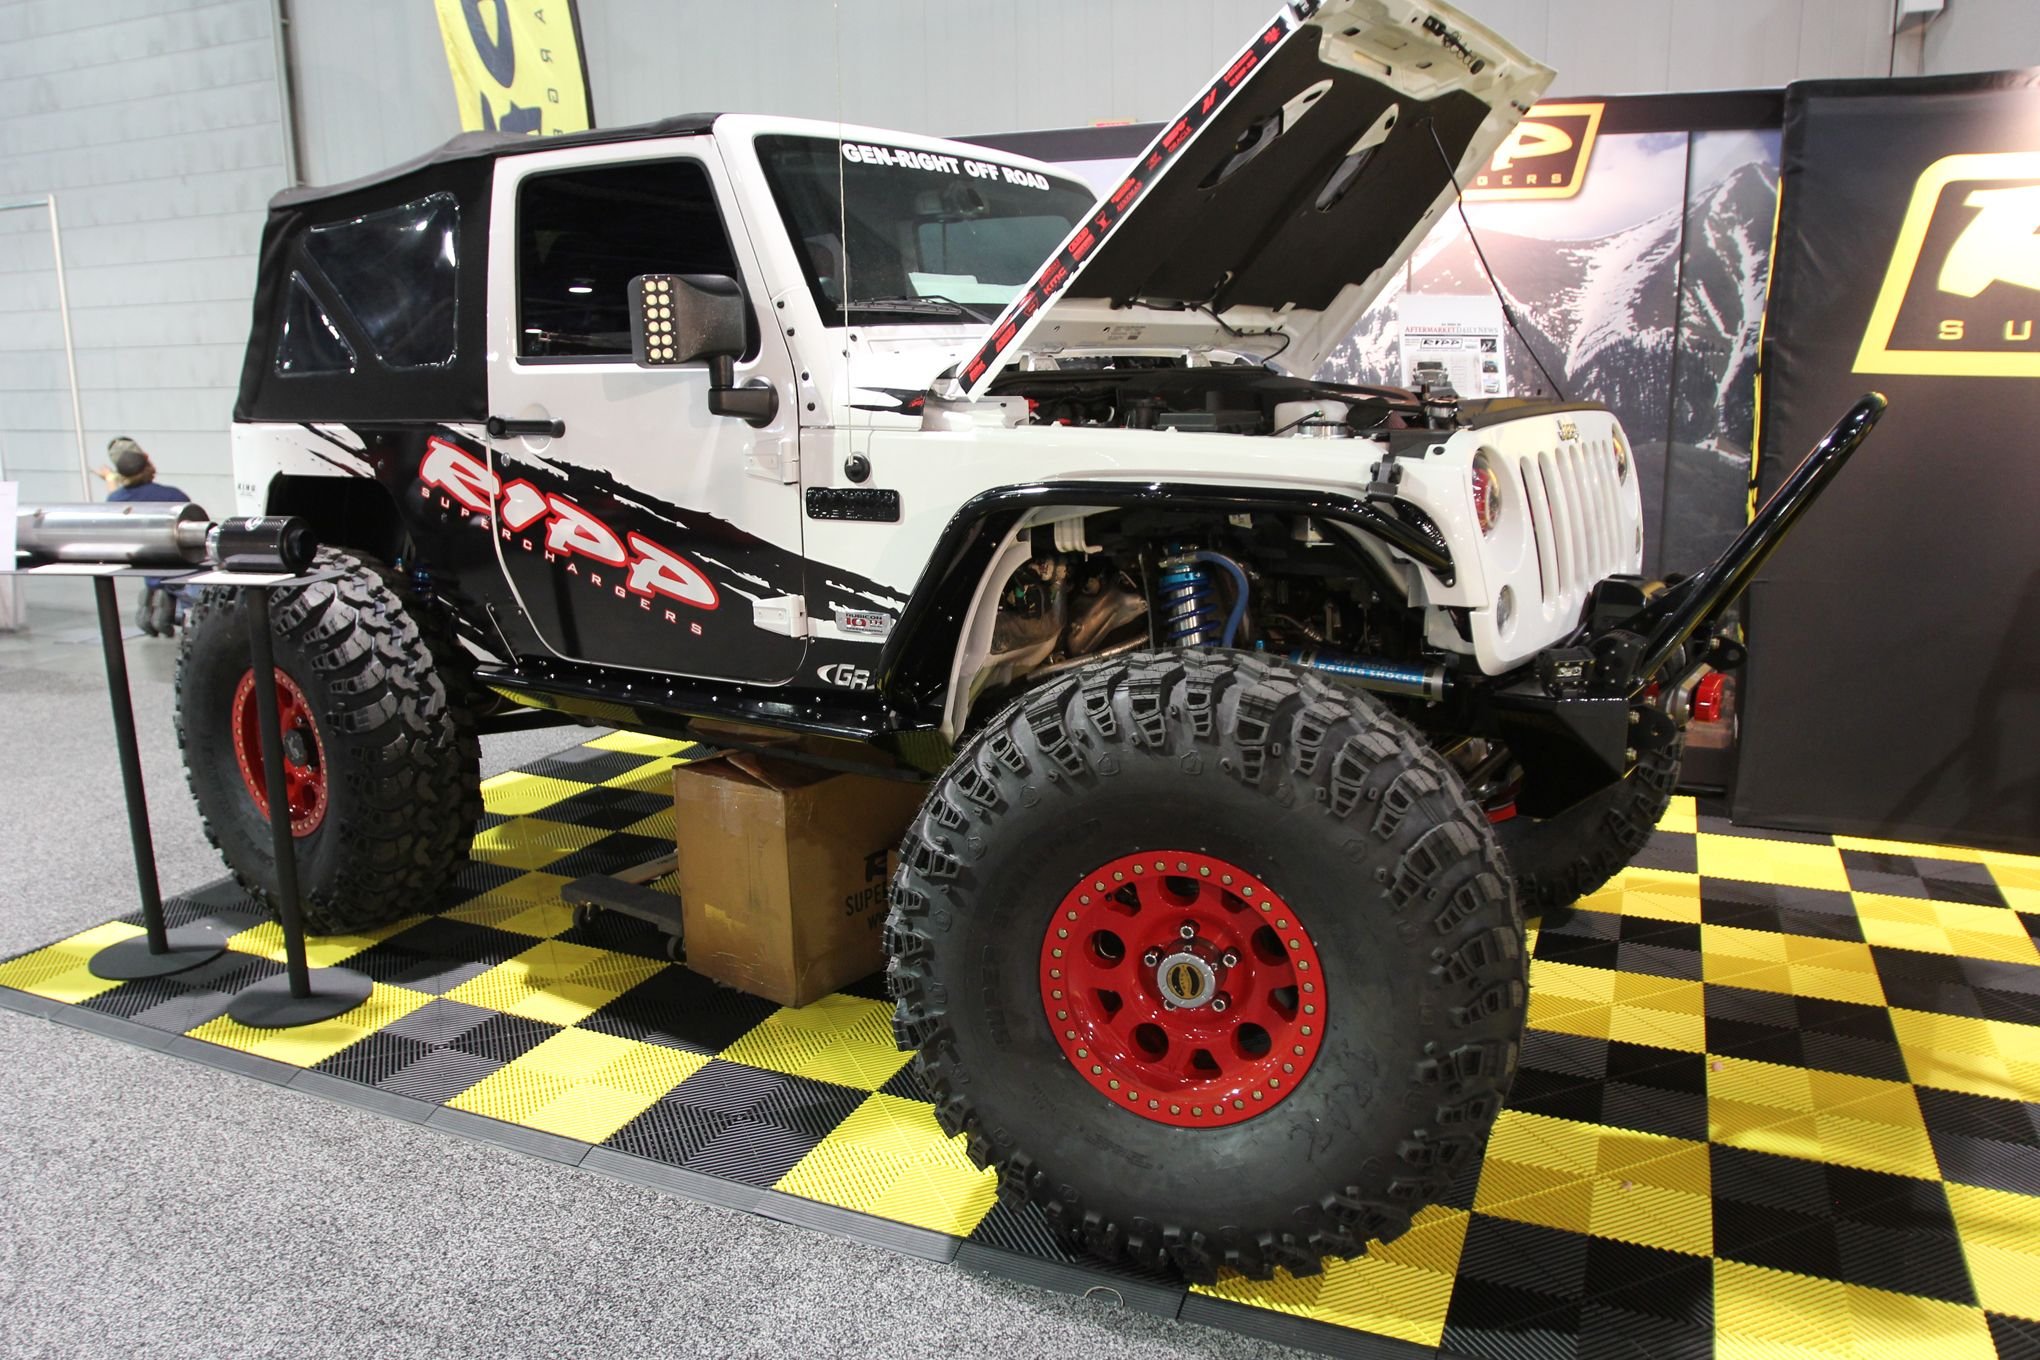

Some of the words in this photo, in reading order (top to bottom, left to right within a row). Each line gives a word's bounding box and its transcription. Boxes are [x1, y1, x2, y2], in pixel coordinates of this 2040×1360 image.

[841, 142, 960, 175] GEN-RIGHT
[963, 160, 1000, 181] OFF
[1000, 166, 1050, 191] ROAD
[1405, 326, 1456, 334] AFTERMARKET
[419, 435, 719, 611] RIPP
[420, 486, 703, 635] SUPERCHARGERS
[1368, 669, 1418, 682] SHOCKS
